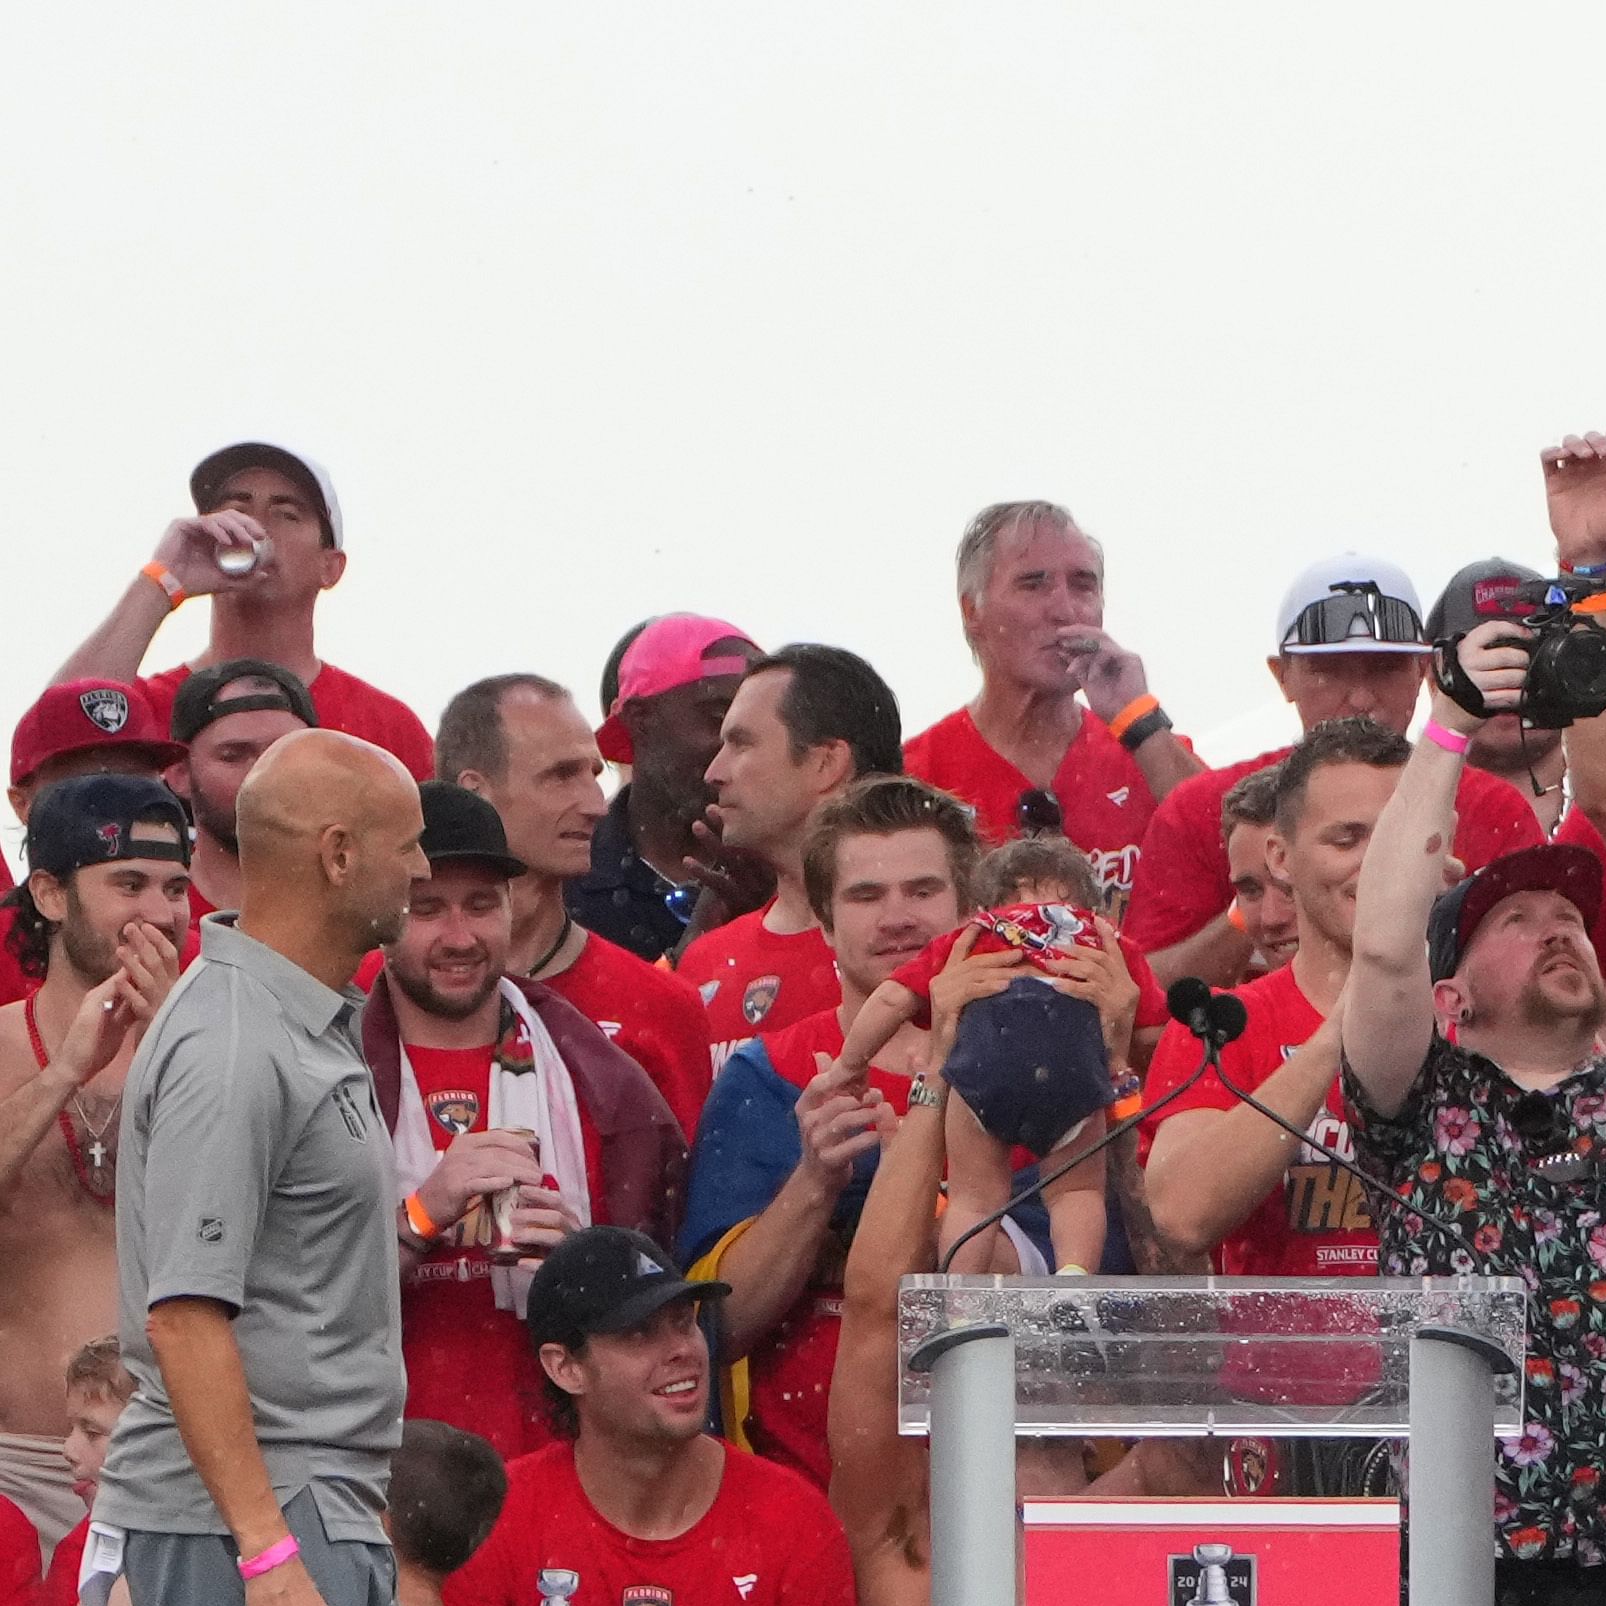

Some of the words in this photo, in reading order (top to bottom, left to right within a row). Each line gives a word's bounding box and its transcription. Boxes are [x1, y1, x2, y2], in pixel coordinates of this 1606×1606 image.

[1316, 1248, 1366, 1262] STANLEY
[1178, 1575, 1195, 1588] 20
[1230, 1575, 1249, 1588] 24
